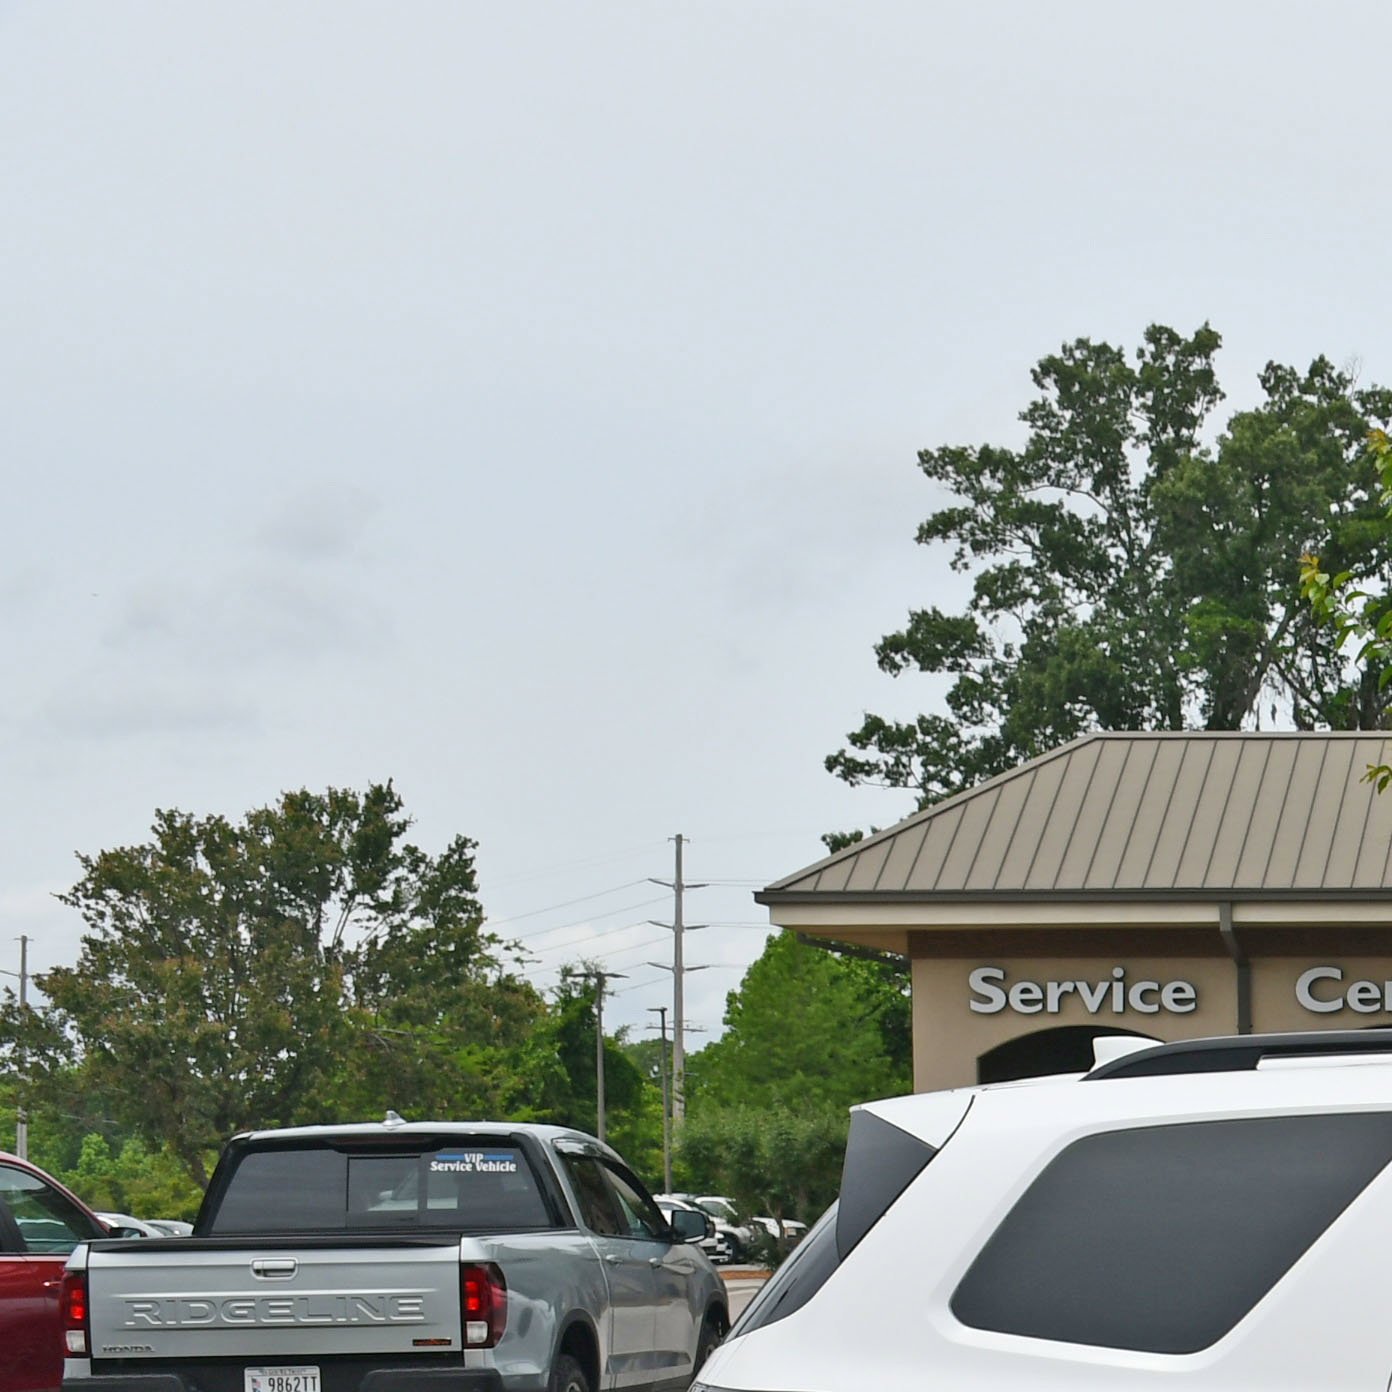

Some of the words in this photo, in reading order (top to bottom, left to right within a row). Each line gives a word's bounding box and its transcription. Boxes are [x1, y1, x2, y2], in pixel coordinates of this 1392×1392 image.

[967, 966, 1198, 1015] Service
[463, 1153, 484, 1163] VIP
[430, 1161, 473, 1172] Service
[475, 1161, 517, 1172] Vehicle
[125, 1295, 425, 1326] RIDGELINE
[268, 1376, 318, 1392] 9862TT
